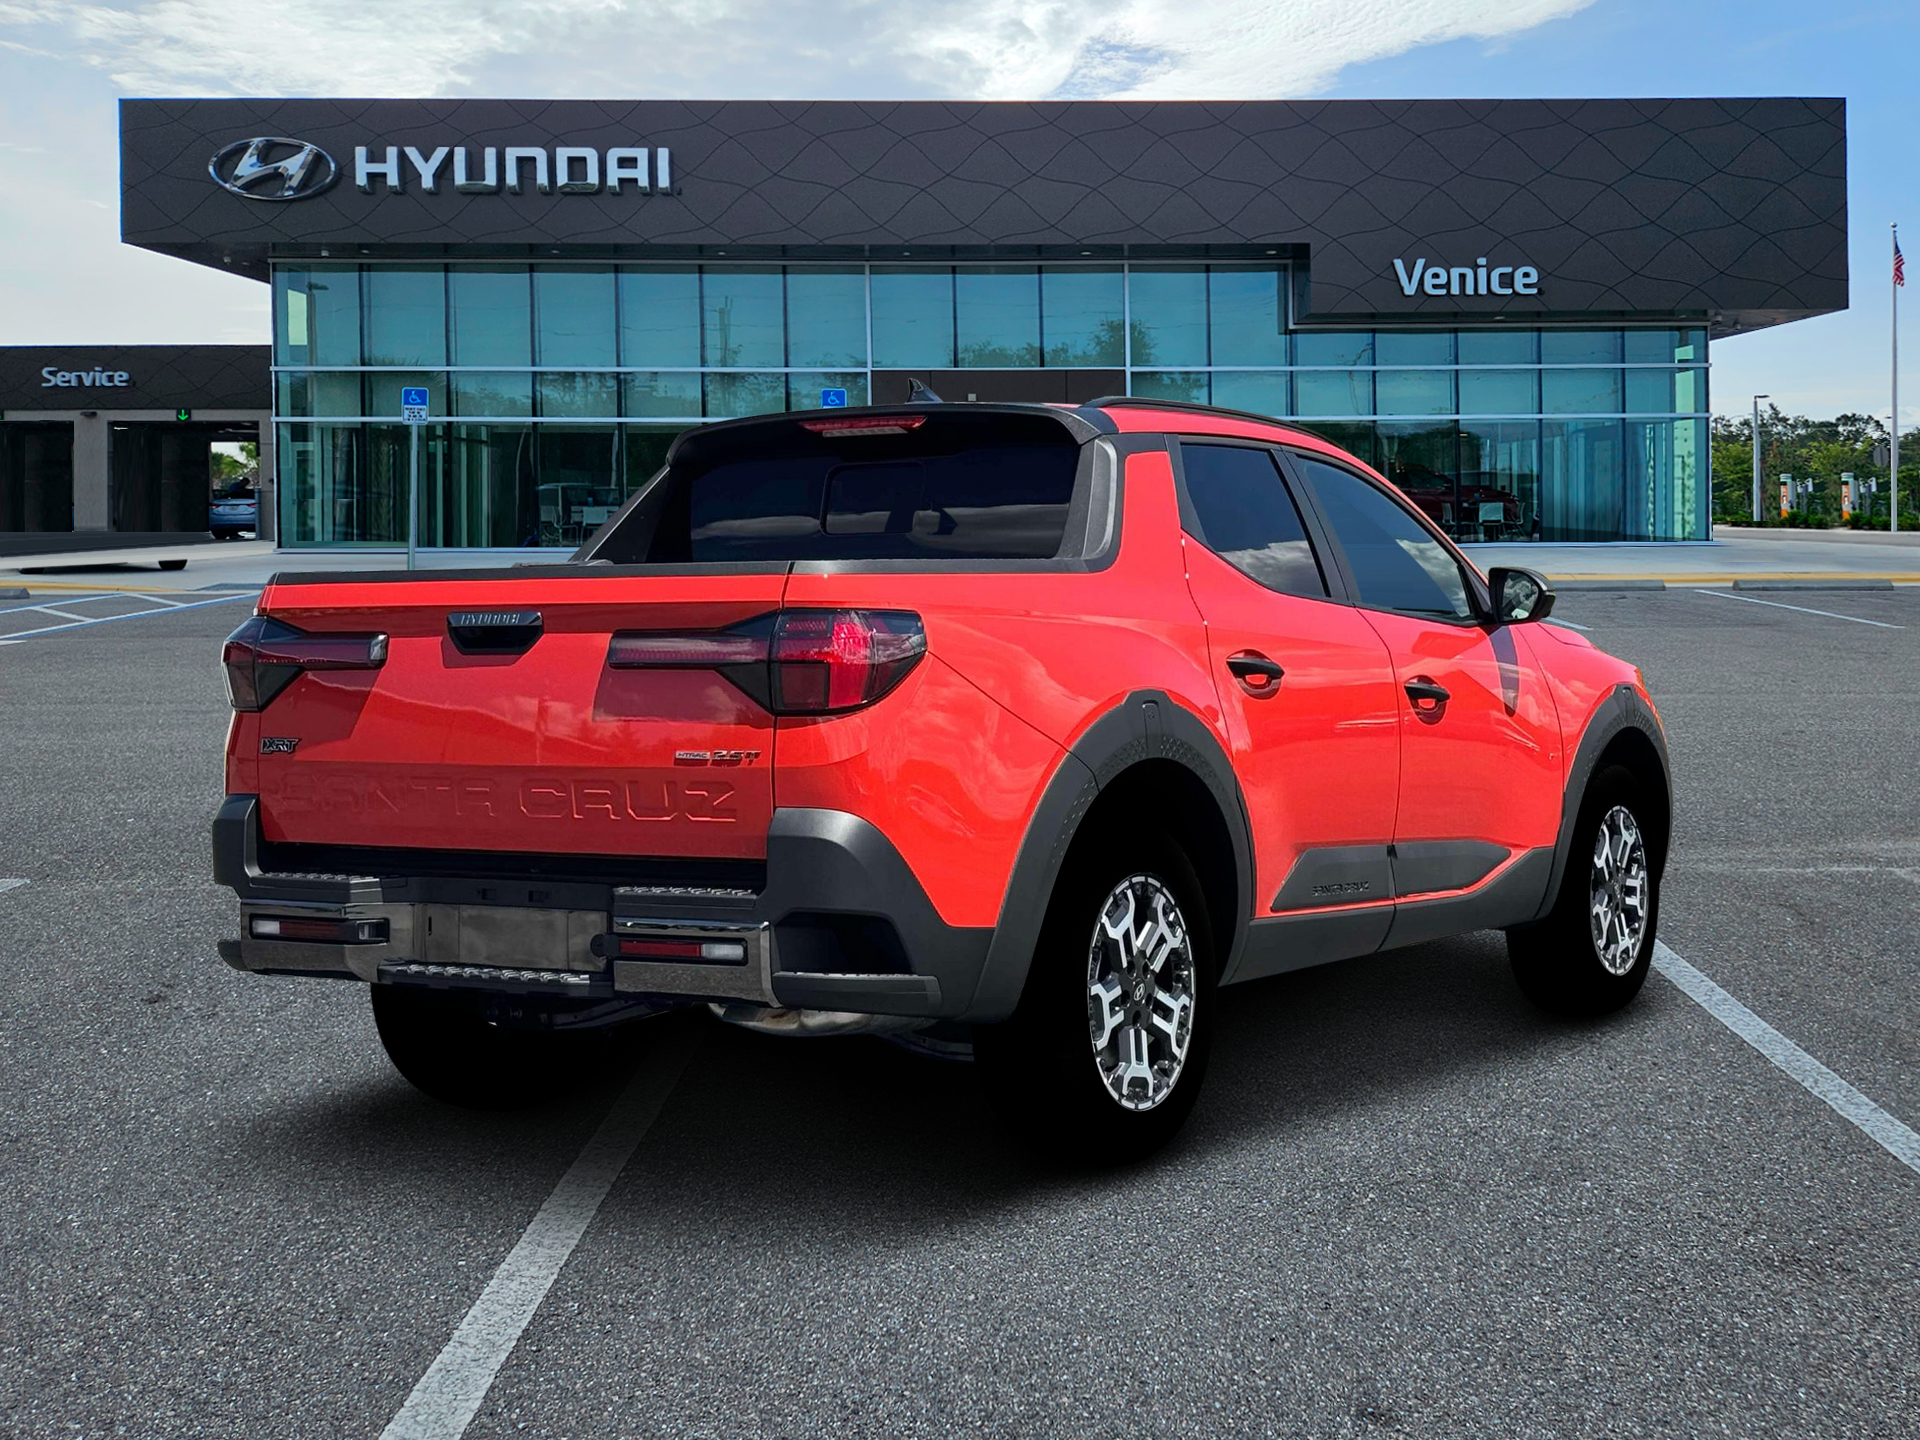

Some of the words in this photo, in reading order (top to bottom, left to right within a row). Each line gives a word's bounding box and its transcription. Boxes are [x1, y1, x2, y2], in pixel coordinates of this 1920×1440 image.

[354, 146, 671, 194] HYUNDAI
[1392, 257, 1539, 295] Venice
[41, 367, 130, 387] Service
[261, 738, 299, 753] XRT
[519, 777, 738, 823] CRUZ
